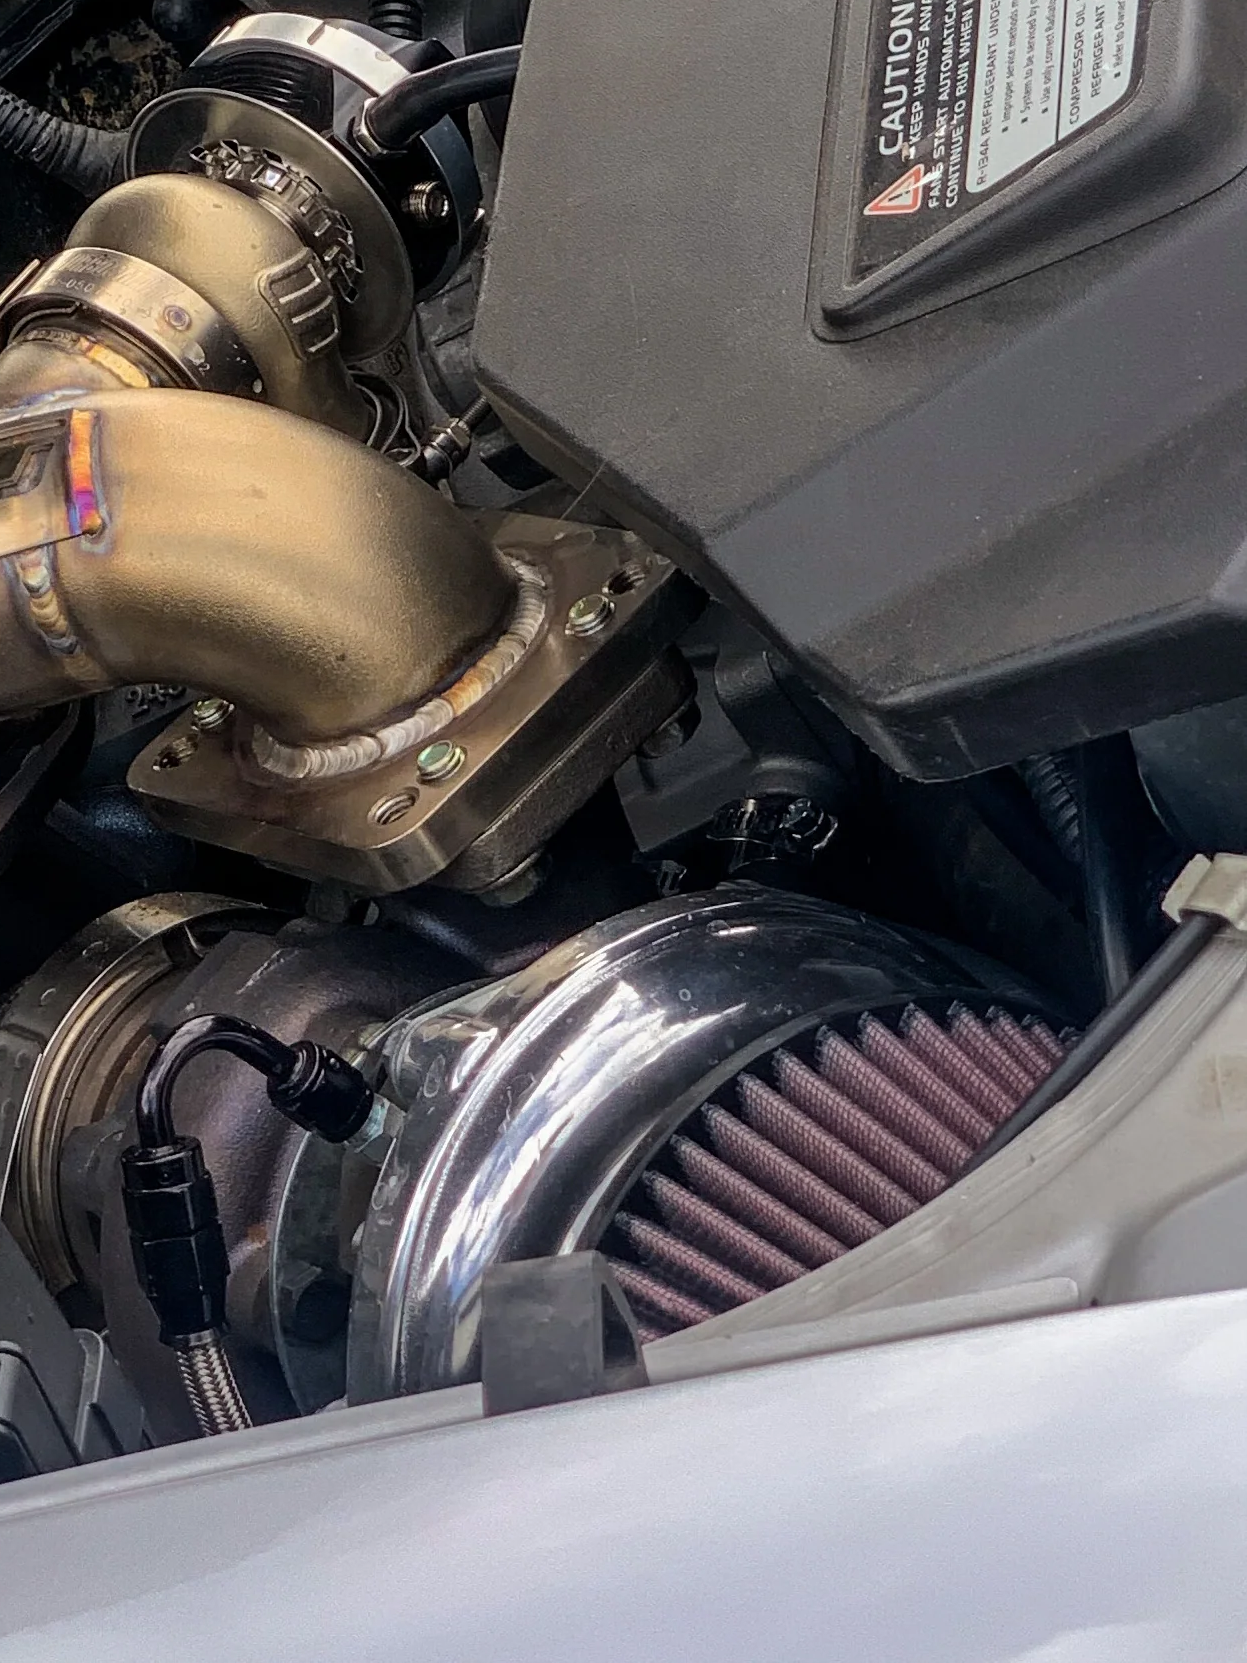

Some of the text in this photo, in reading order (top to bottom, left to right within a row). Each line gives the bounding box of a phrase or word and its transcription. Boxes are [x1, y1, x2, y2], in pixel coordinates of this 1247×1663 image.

[1006, 7, 1019, 48] methods
[1026, 4, 1038, 18] by
[957, 7, 972, 59] WHEN
[1023, 17, 1037, 55] serviced
[1042, 31, 1056, 64] correct
[1089, 2, 1105, 98] REFRIGERANT
[1112, 30, 1124, 43] to
[912, 35, 929, 96] HANDS
[1004, 47, 1017, 80] service
[1021, 67, 1033, 80] to
[1022, 53, 1034, 68] be
[1111, 42, 1123, 68] Refer
[954, 60, 969, 97] RUN
[980, 40, 997, 136] REFRIGERANT
[1041, 63, 1054, 86] only
[1068, 29, 1083, 125] COMPRESSOR
[952, 97, 966, 122] TO
[1001, 78, 1015, 123] Improper
[1019, 79, 1033, 114] System
[1040, 84, 1052, 104] Use
[908, 98, 924, 145] KEEP
[932, 103, 948, 159] START
[946, 124, 964, 208] CONTINUE
[976, 136, 990, 186] R-134A
[928, 160, 944, 209] FANS
